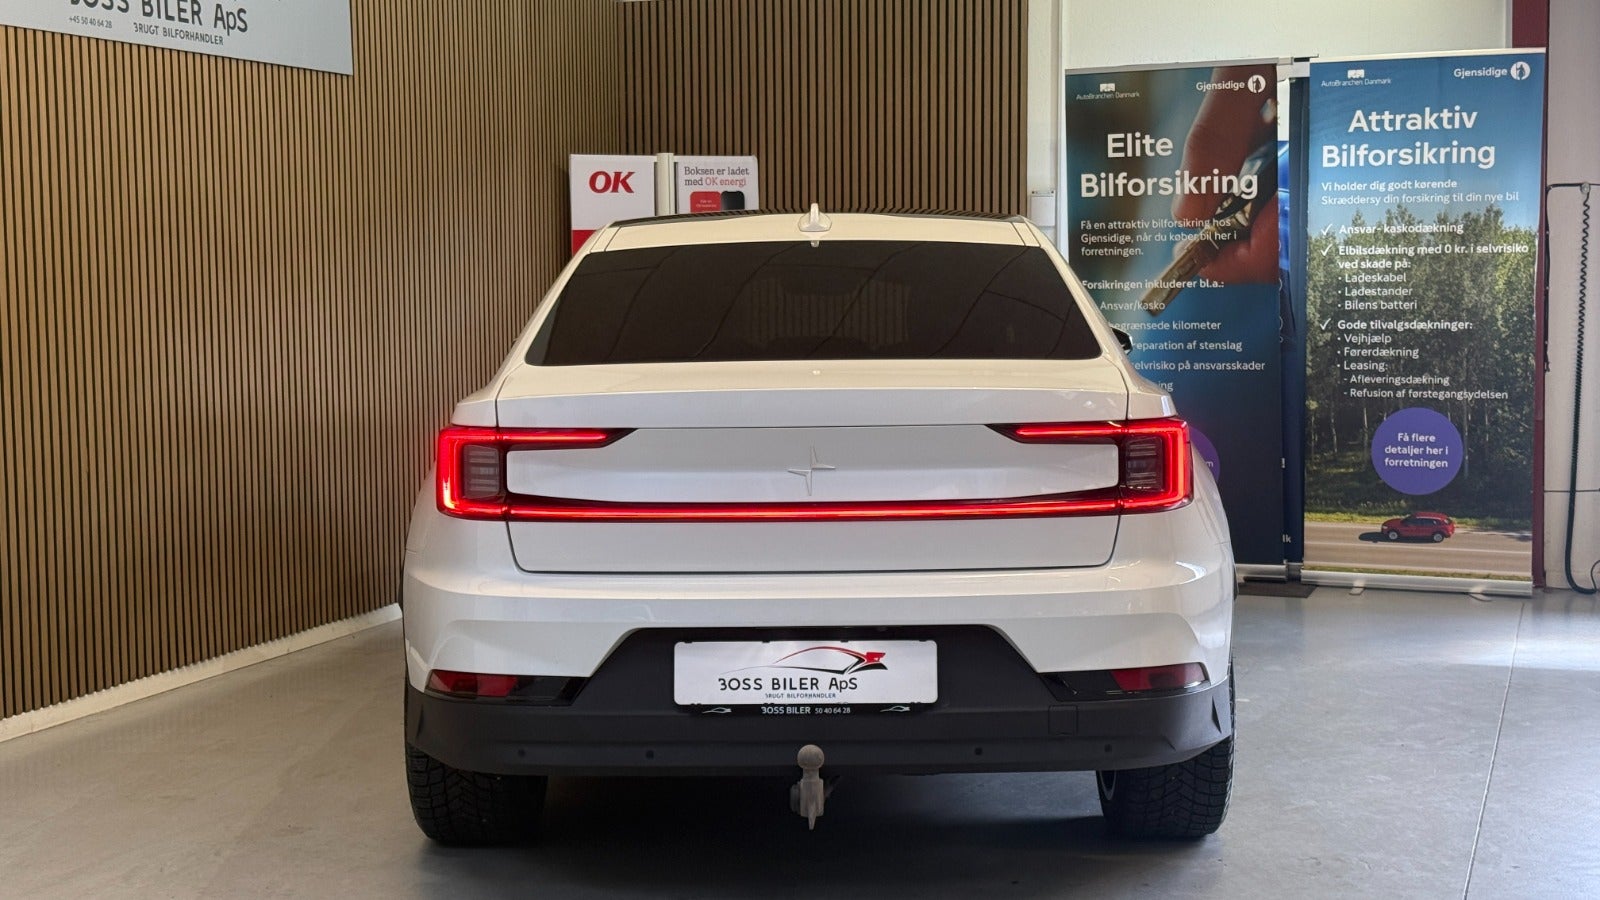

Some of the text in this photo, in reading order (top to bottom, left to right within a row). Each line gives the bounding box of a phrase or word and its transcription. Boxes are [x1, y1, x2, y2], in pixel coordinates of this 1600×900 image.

[213, 3, 248, 36] ApS
[162, 27, 224, 46] BILFORHANDLER
[1453, 67, 1508, 79] Gjensidige
[1196, 80, 1246, 93] Gjensidige
[1347, 105, 1478, 133] Attraktiv
[1107, 131, 1174, 158] Elite
[1321, 140, 1496, 169] Bilforsikring
[684, 166, 750, 176] Boksen er ladet
[588, 170, 636, 194] OK
[684, 177, 747, 188] med OK energi
[1080, 168, 1258, 200] Bilforsikring
[1321, 179, 1458, 192] Vi holder dig godt kørende
[1321, 190, 1519, 206] Skræddersy din forsikring til din nye bil
[1080, 217, 1231, 230] Få en attraktiv bilforsikring hos
[1383, 223, 1464, 235] kaskodækning
[1081, 233, 1134, 245] Gjensidige,
[1136, 234, 1152, 242] når
[1154, 232, 1167, 242] du
[1169, 232, 1199, 242] køber
[1200, 231, 1212, 241] bil
[1214, 230, 1232, 241] her
[1081, 246, 1144, 257] forretningen.
[1339, 245, 1415, 257] Elbilsdækning
[1417, 244, 1442, 254] med
[1444, 244, 1452, 253] 0
[1454, 244, 1468, 253] kr.
[1476, 243, 1529, 254] selvrisiko
[1338, 258, 1412, 270] ved skade på:
[1345, 273, 1407, 283] Ladeskabel
[1082, 279, 1225, 291] Forsikringen inkluderer bl.a.:
[1345, 287, 1413, 297] Ladestander
[1100, 301, 1166, 311] Ansvar/kasko
[1344, 300, 1418, 310] Bilens batteri
[1172, 320, 1222, 330] kilometer
[1337, 319, 1474, 332] Gode tilvalgsdækninger:
[1186, 340, 1198, 350] af
[1199, 341, 1243, 353] stenslag
[1344, 334, 1392, 346] Vejhjælp
[1343, 347, 1420, 360] Førerdækning
[1132, 360, 1266, 371] elvrisiko på ansvarsskader
[1343, 361, 1389, 373] Leasing:
[1350, 375, 1450, 387] Afleveringsdækning
[1350, 388, 1509, 402] Refusion af førstegangsydelsen
[1397, 432, 1436, 442] Få flere
[1384, 444, 1424, 457] detaljer
[1425, 445, 1444, 455] her
[1384, 457, 1449, 470] forretningen
[771, 677, 819, 691] BILER
[828, 677, 858, 693] ApS
[786, 706, 811, 714] BILER
